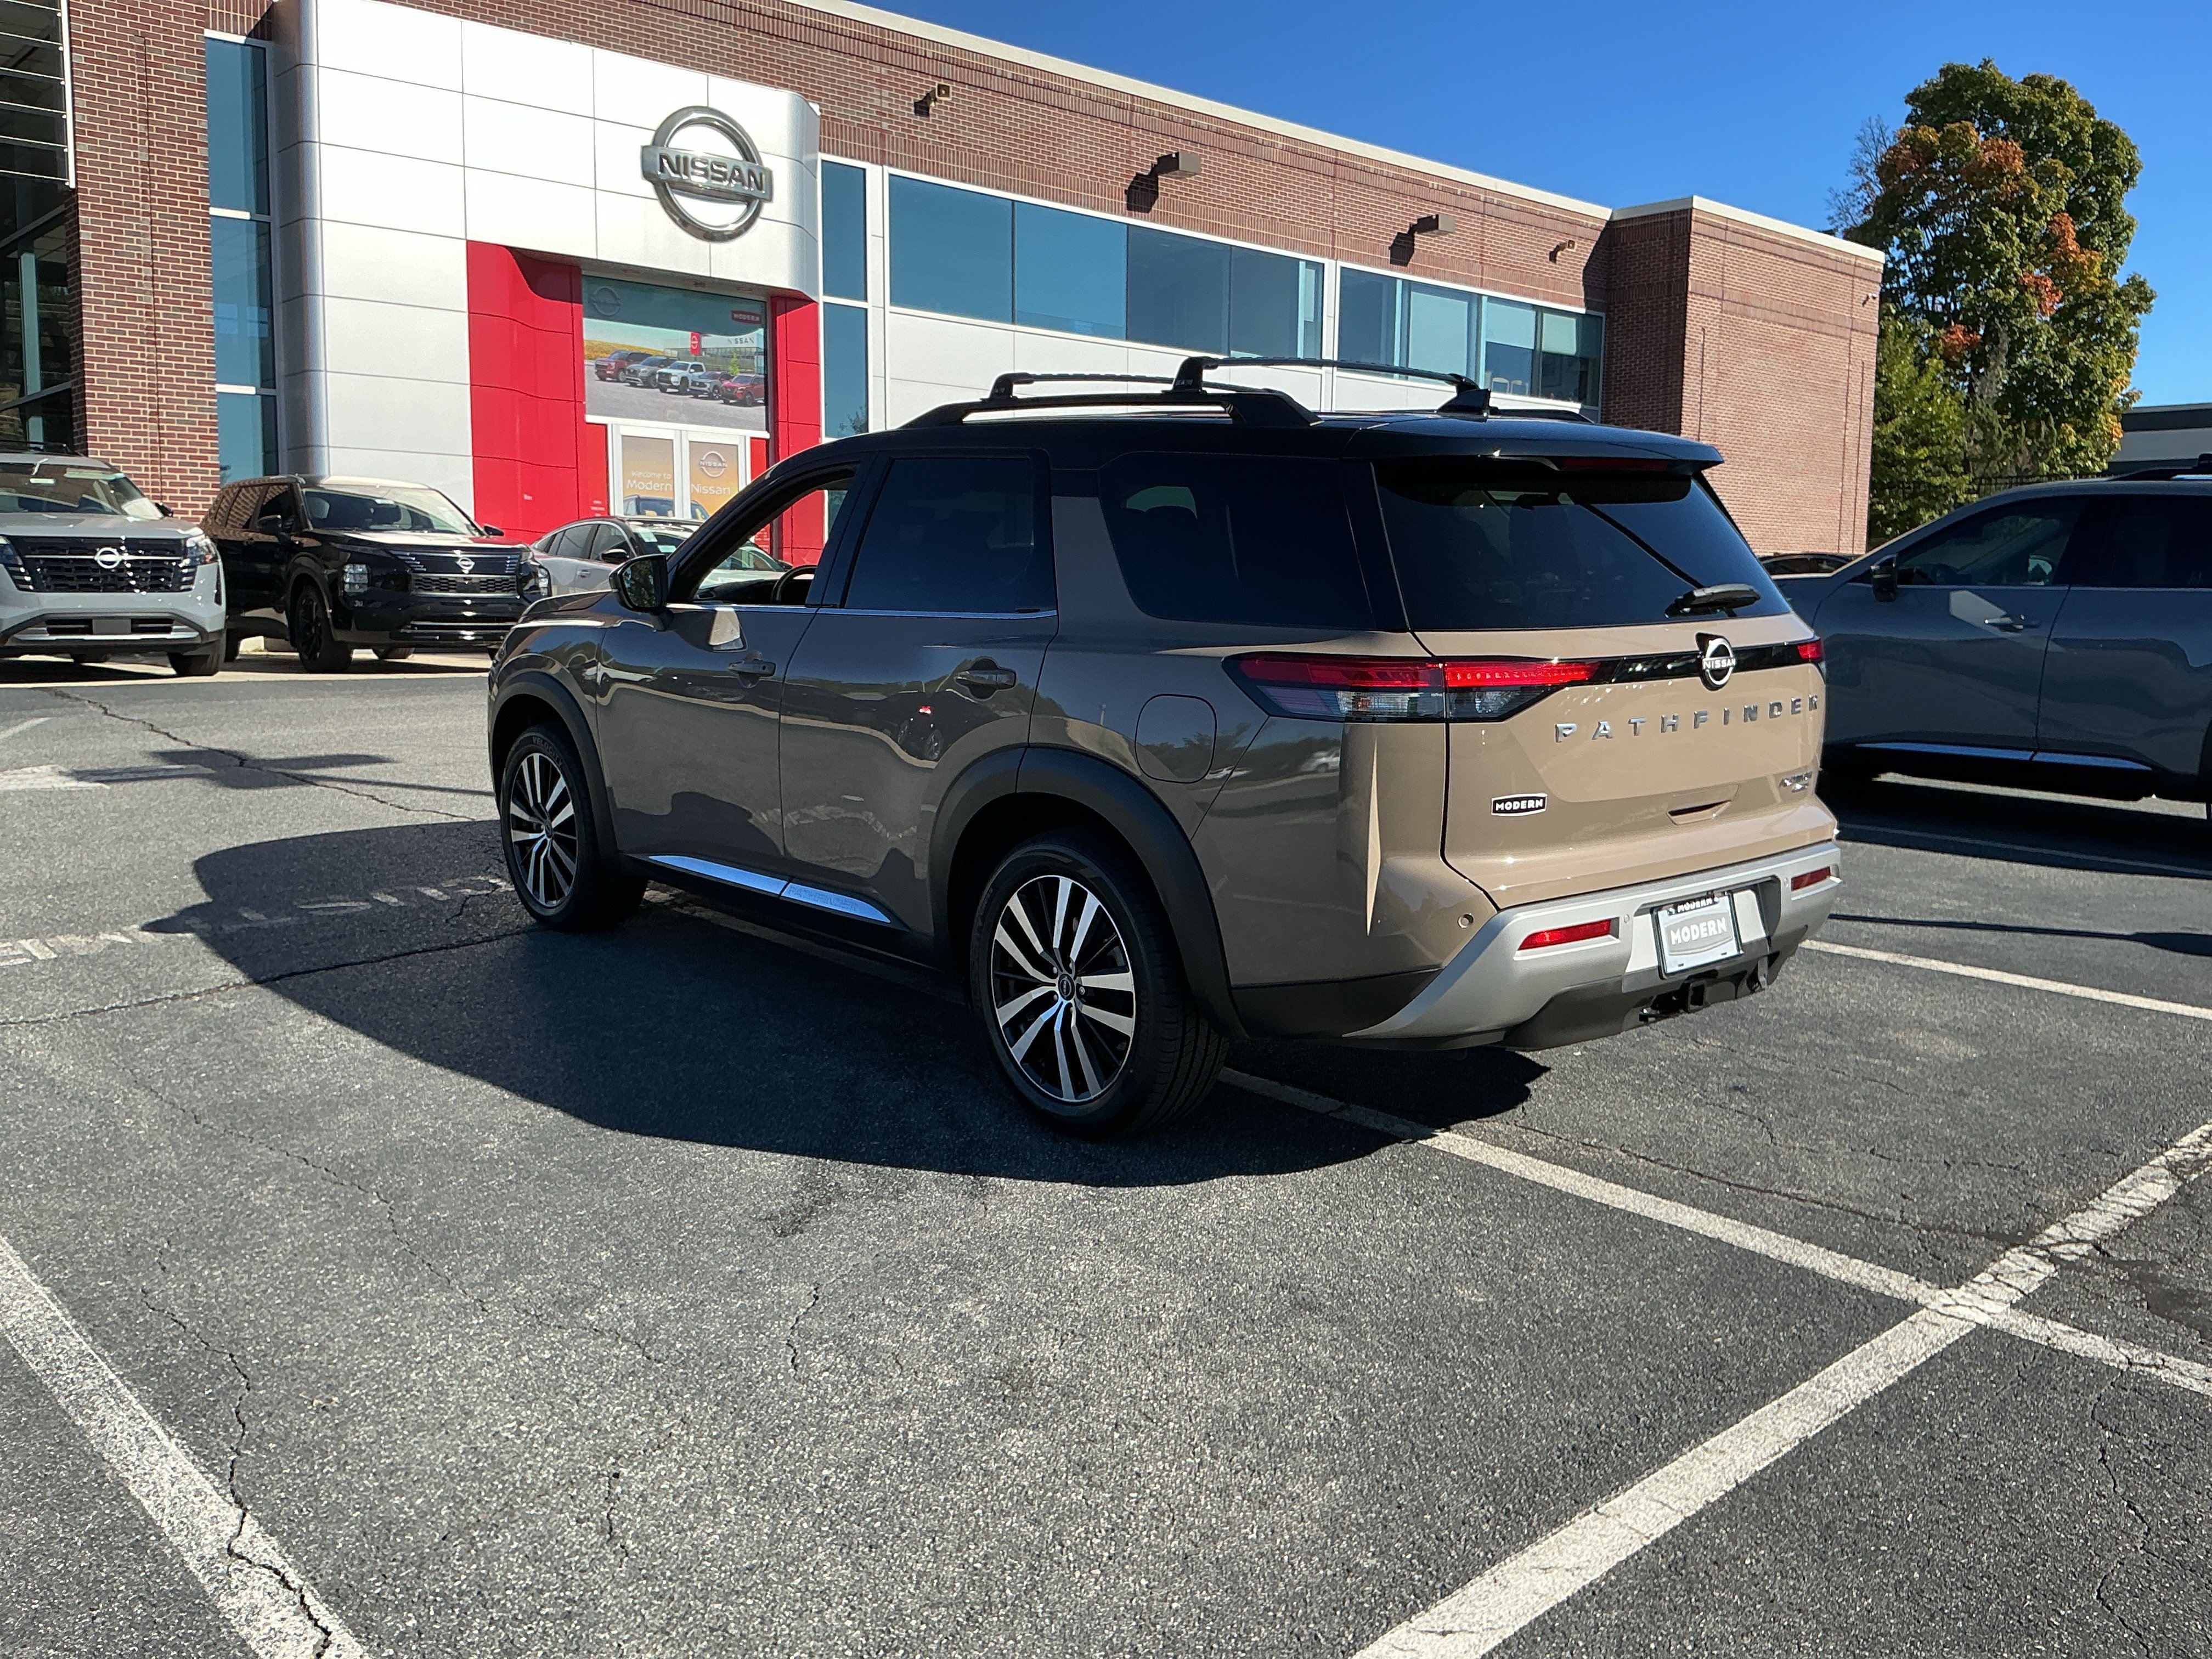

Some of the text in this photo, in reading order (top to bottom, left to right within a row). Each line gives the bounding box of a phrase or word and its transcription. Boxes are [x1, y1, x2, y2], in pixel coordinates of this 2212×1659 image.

[659, 153, 765, 194] NISSAN
[631, 471, 662, 479] Welcome
[627, 479, 673, 492] Modern
[691, 483, 731, 495] Nissan
[1702, 658, 1736, 670] NISSAN
[1554, 695, 1818, 743] PATHFINDER
[1495, 798, 1543, 811] MODERN
[1670, 917, 1727, 945] MODERN
